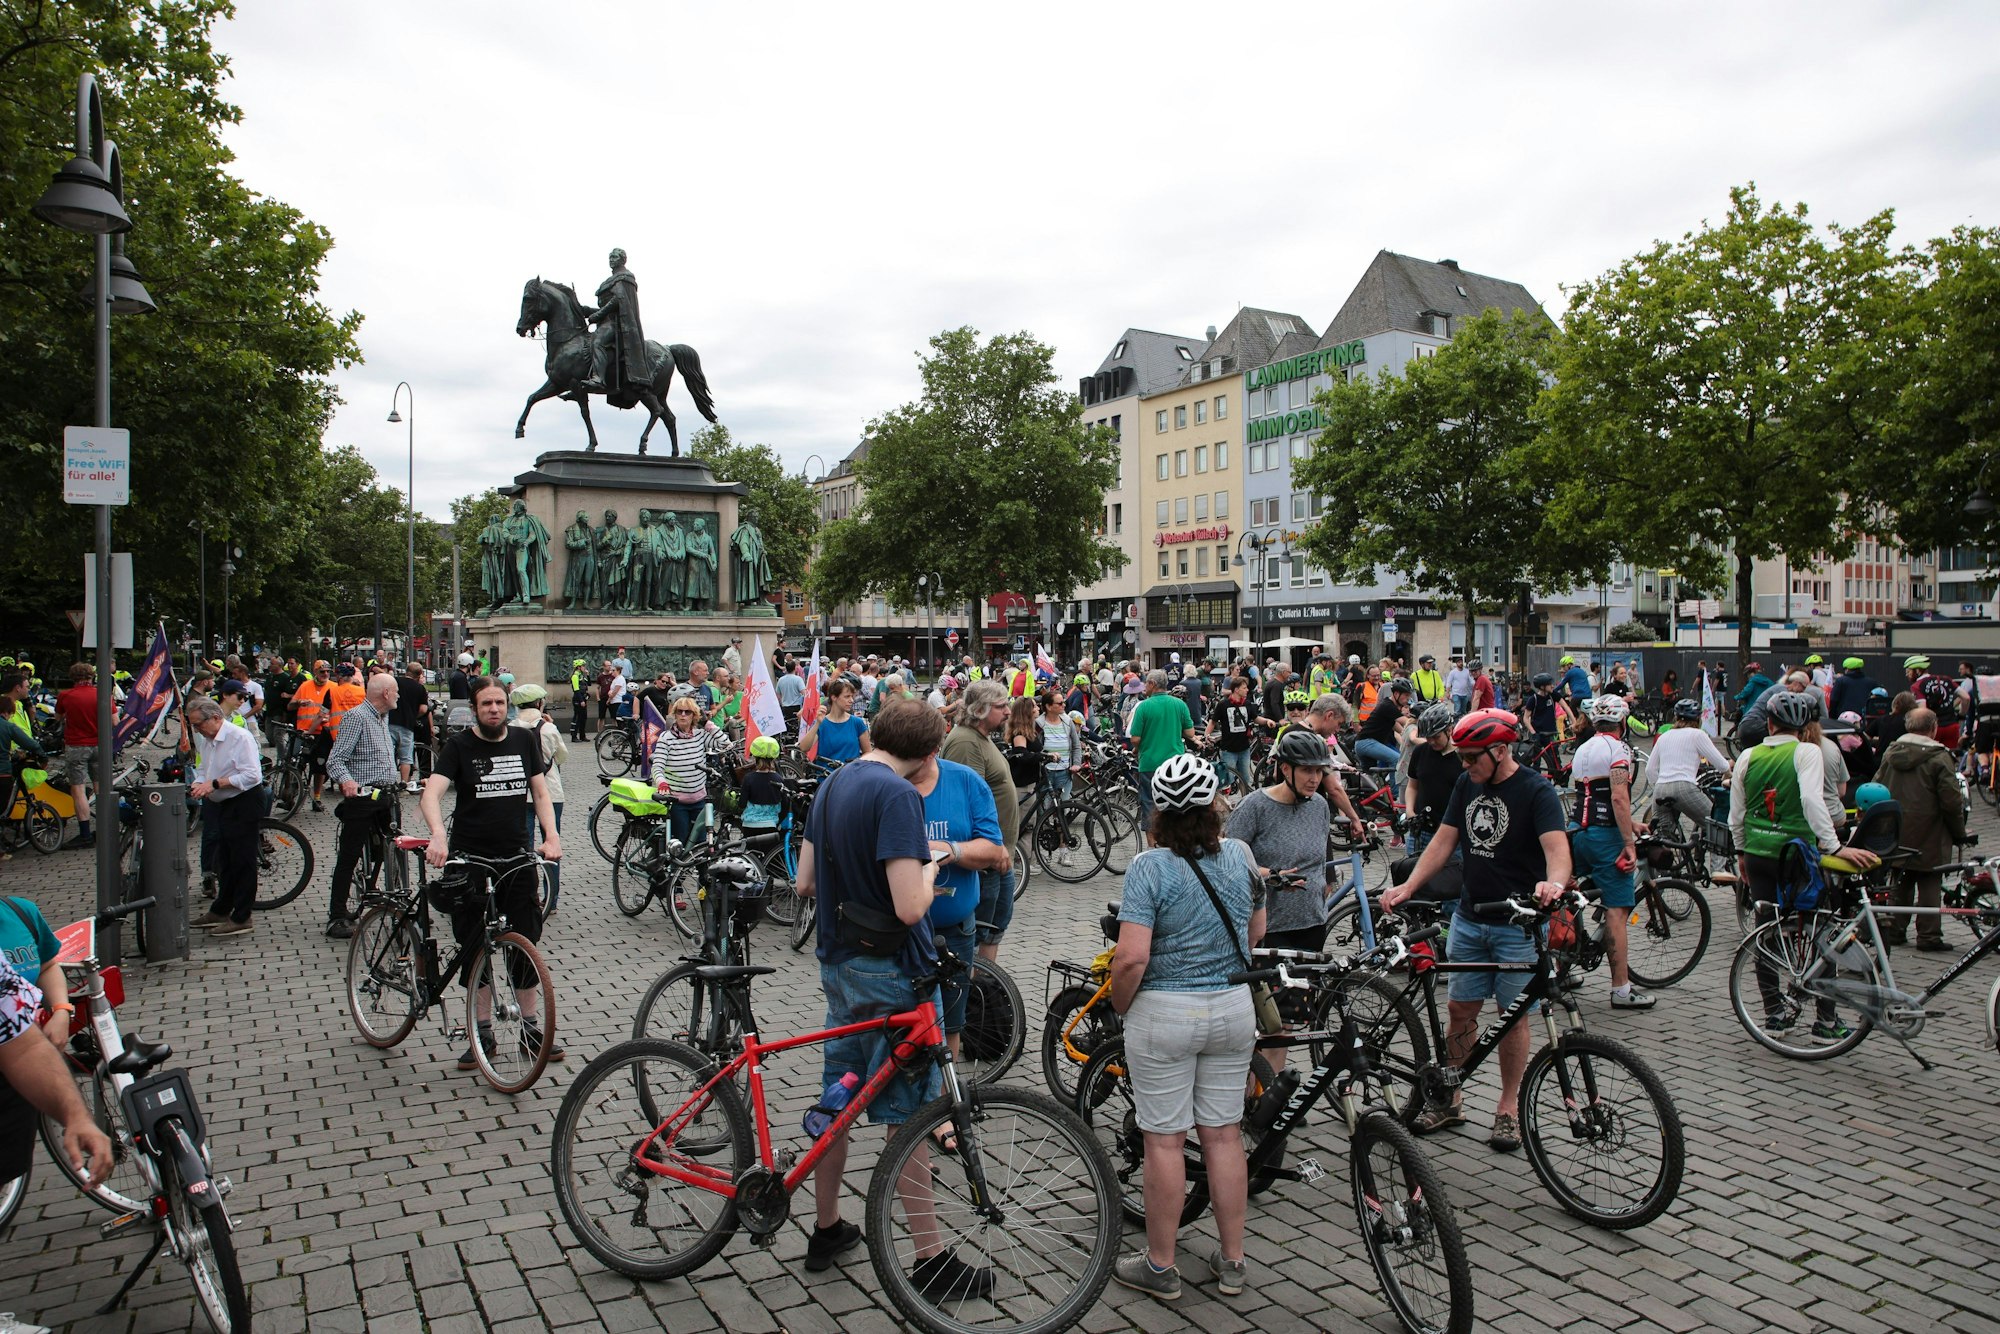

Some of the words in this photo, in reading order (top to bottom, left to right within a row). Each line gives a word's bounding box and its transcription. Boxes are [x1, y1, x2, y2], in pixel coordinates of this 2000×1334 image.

[1245, 339, 1366, 391] LAMMERTING
[67, 458, 95, 469] Free
[98, 459, 126, 470] WiFi
[68, 470, 86, 480] für
[88, 471, 116, 481] alle!
[1277, 608, 1302, 619] Trattoria
[1393, 605, 1415, 616] rattoria
[1096, 621, 1111, 632] ART
[475, 782, 508, 792] TRUCK
[509, 780, 528, 789] YOU
[1479, 992, 1530, 1046] CANYON
[1272, 1065, 1330, 1131] CANYON
[192, 1181, 209, 1193] DB
